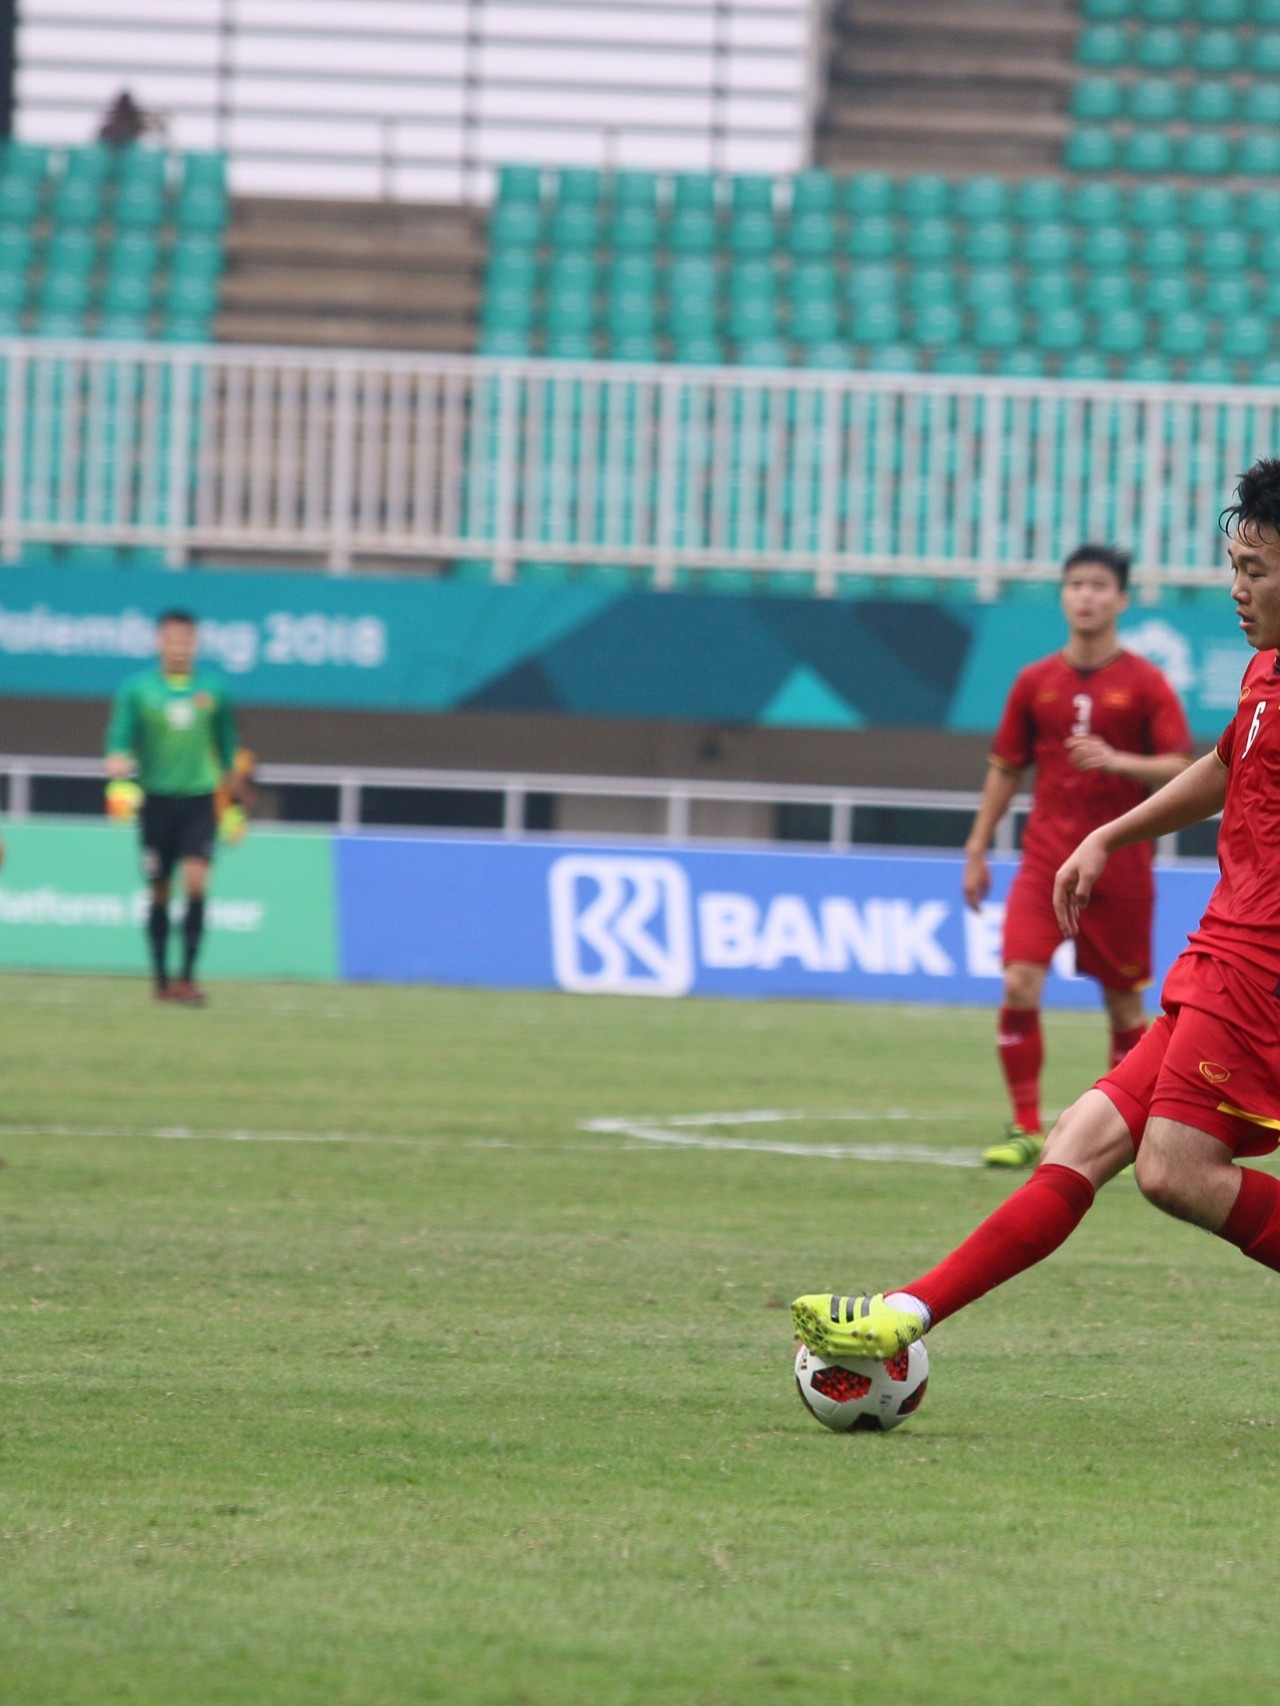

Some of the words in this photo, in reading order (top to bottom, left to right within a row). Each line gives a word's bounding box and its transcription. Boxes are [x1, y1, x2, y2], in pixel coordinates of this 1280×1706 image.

[265, 612, 387, 667] 2018
[1241, 701, 1266, 759] 6
[700, 892, 956, 976] BANK
